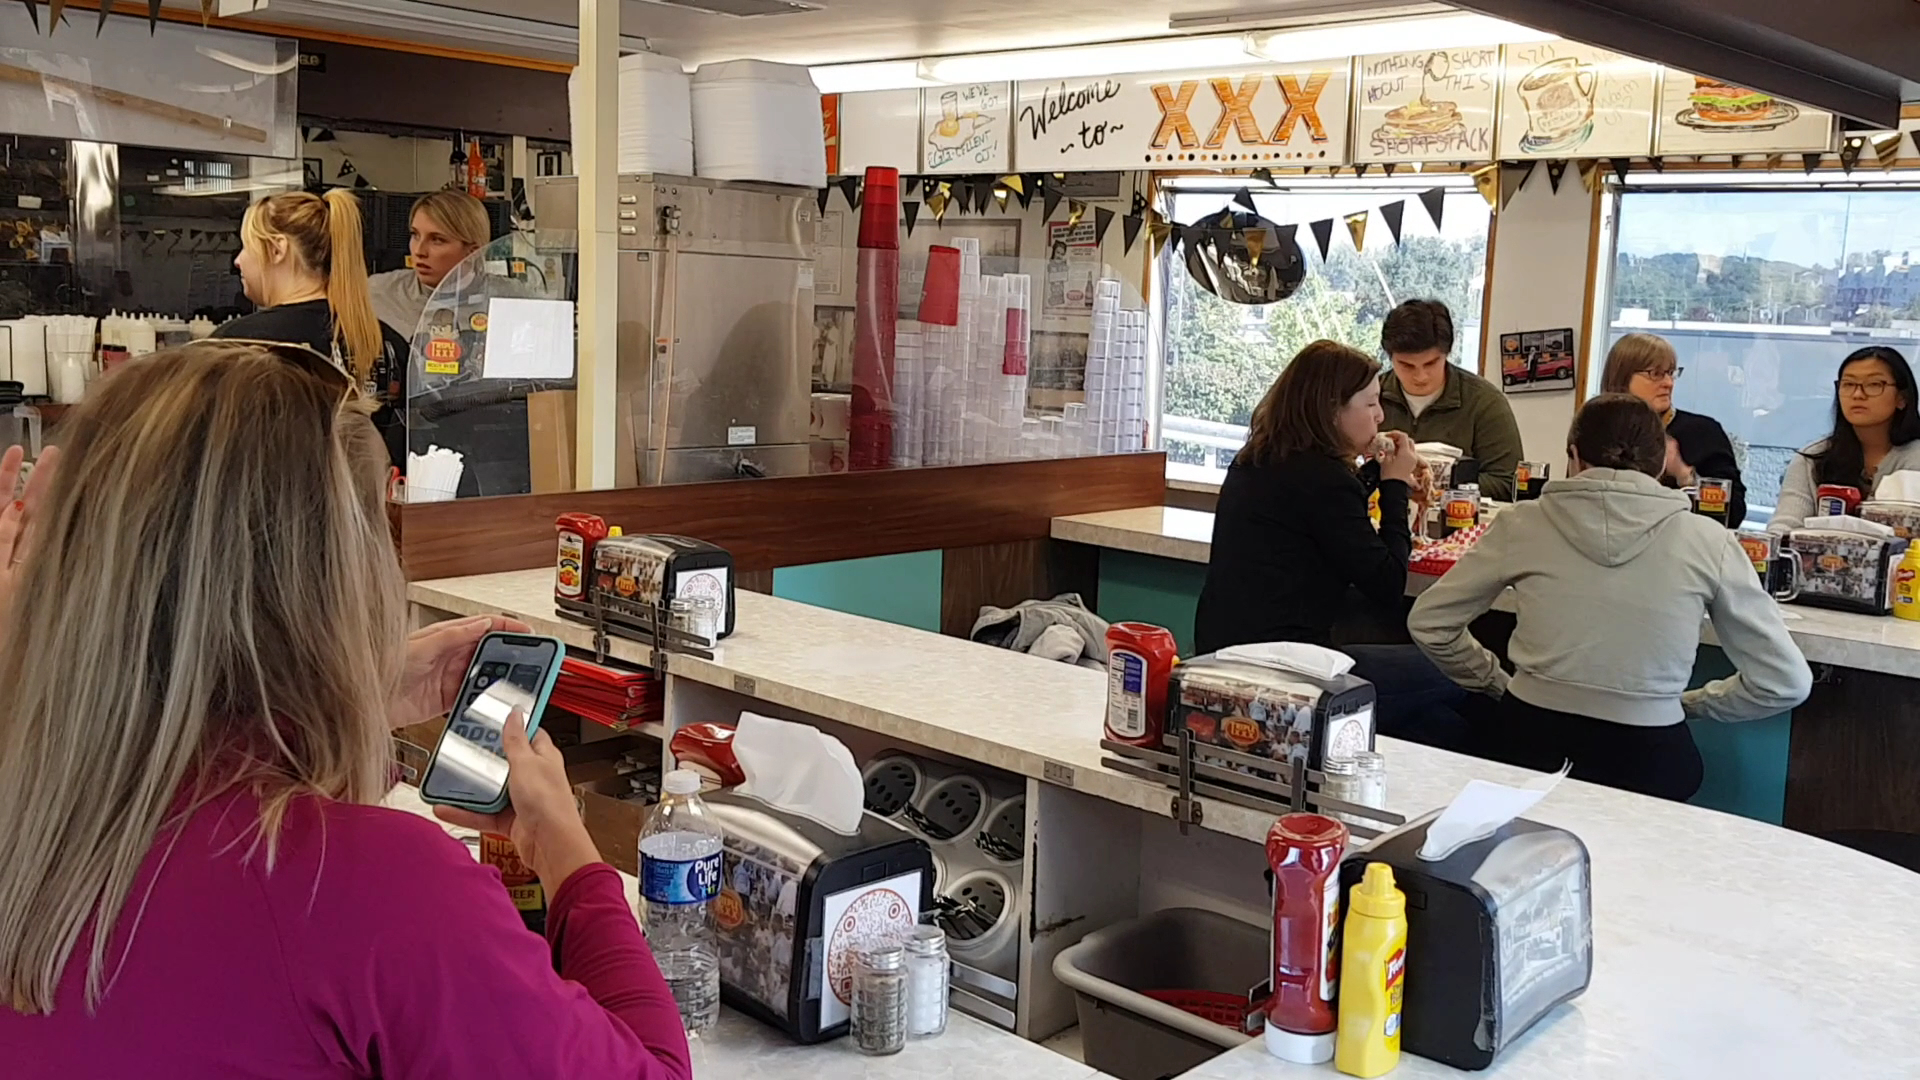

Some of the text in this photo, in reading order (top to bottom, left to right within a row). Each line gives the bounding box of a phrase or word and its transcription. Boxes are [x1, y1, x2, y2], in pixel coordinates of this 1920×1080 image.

[1366, 54, 1425, 77] NOTHING
[1451, 50, 1495, 70] SHORT
[1443, 72, 1491, 92] THIS
[1019, 76, 1121, 140] Welcome
[1148, 68, 1333, 150] XXX
[694, 857, 719, 875] Pure
[698, 869, 718, 888] Life
